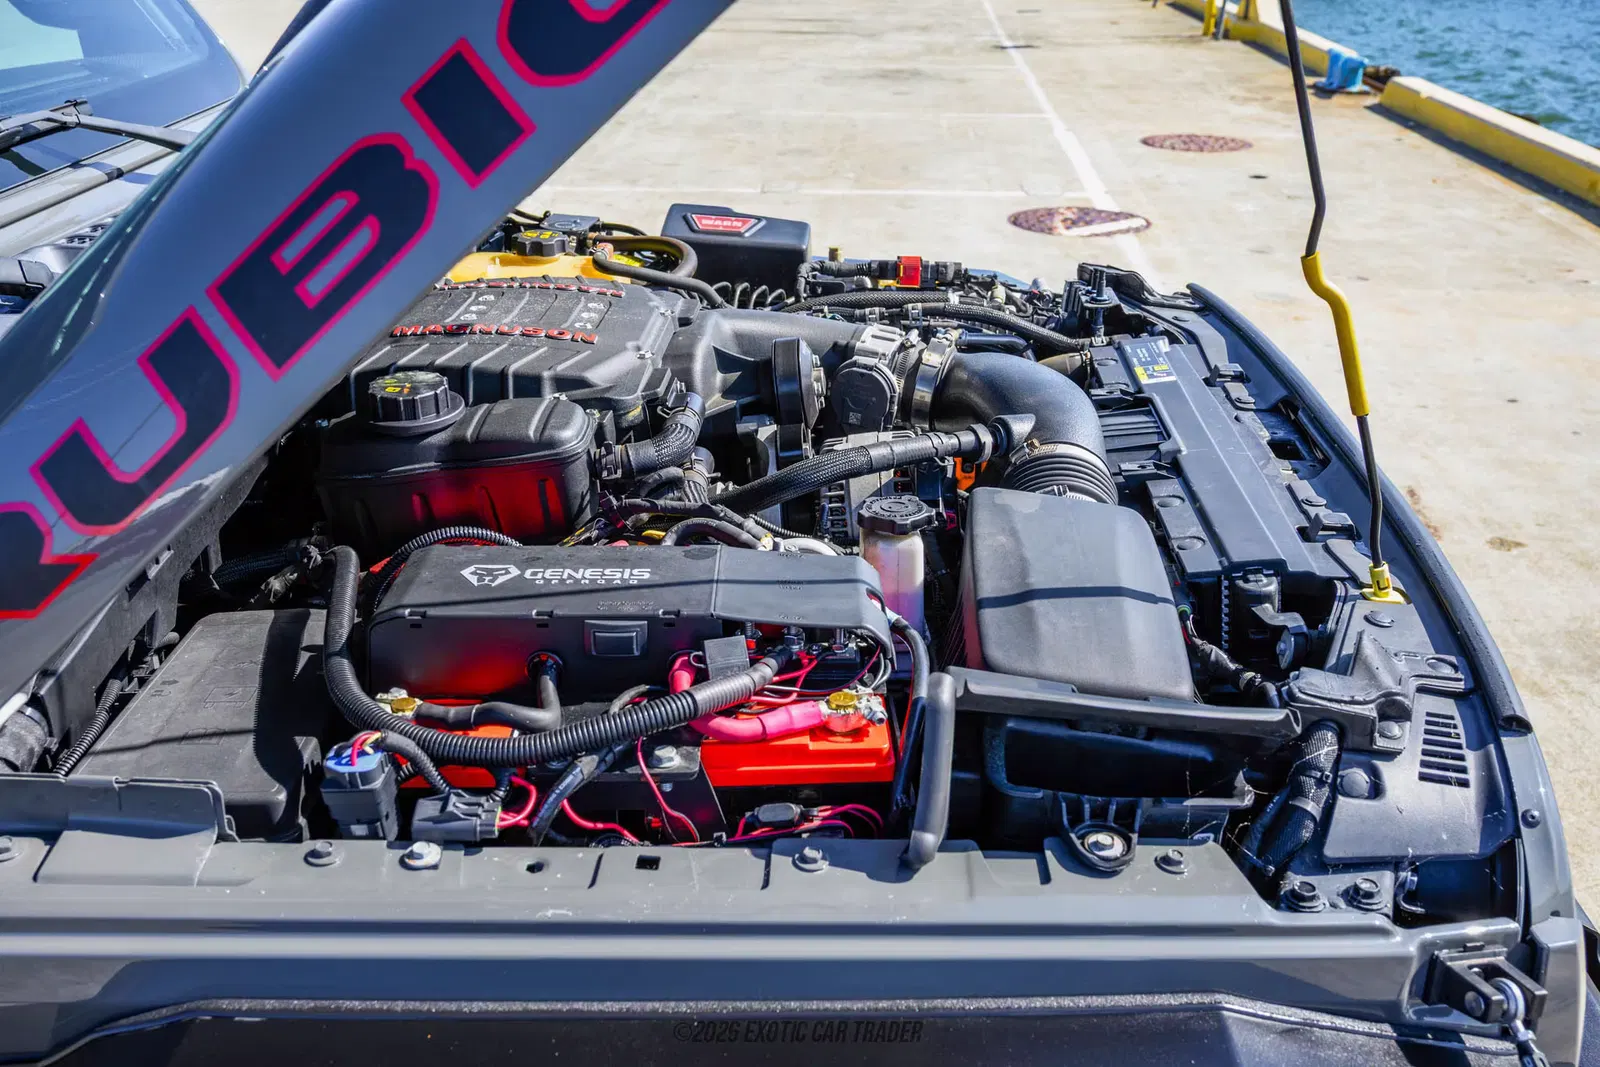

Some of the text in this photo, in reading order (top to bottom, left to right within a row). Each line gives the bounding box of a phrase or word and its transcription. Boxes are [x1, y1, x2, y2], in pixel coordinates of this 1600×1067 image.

[701, 219, 743, 227] WARN
[390, 323, 599, 345] MAGNUSON
[523, 568, 652, 580] GENESIS
